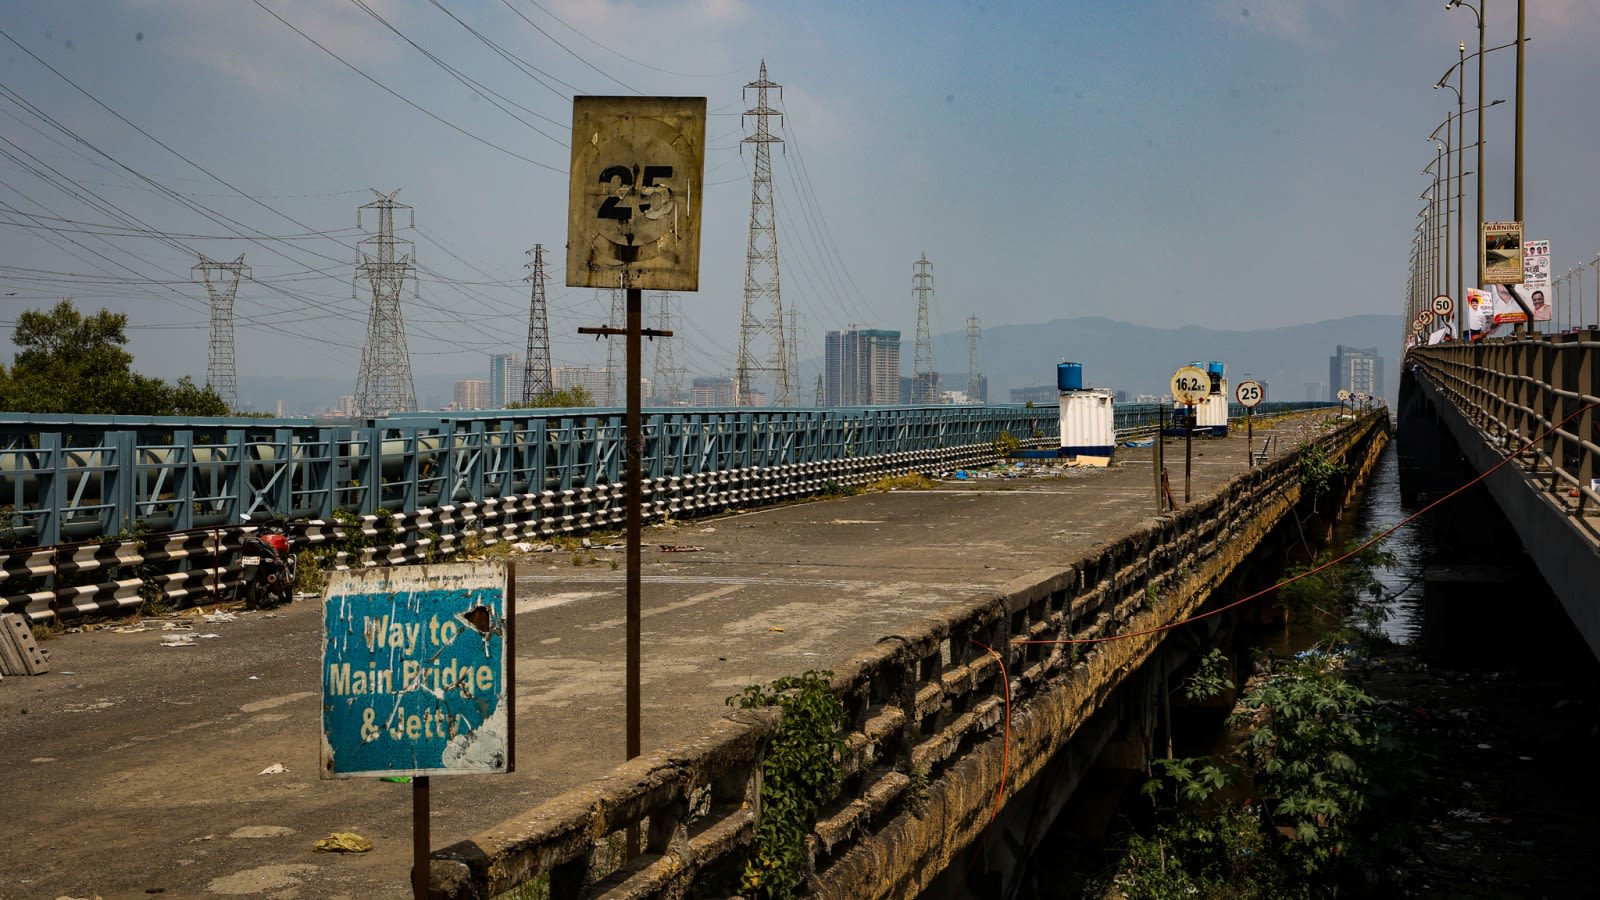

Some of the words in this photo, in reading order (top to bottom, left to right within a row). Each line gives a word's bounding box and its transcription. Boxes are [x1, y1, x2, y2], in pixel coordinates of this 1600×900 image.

[597, 166, 673, 219] 25
[1436, 300, 1449, 310] 50
[1241, 387, 1258, 400] 25
[364, 615, 420, 655] Way
[429, 614, 457, 646] to
[330, 662, 393, 696] Main
[403, 658, 493, 698] Bridge
[361, 708, 380, 742] &
[390, 707, 462, 741] Jetty
